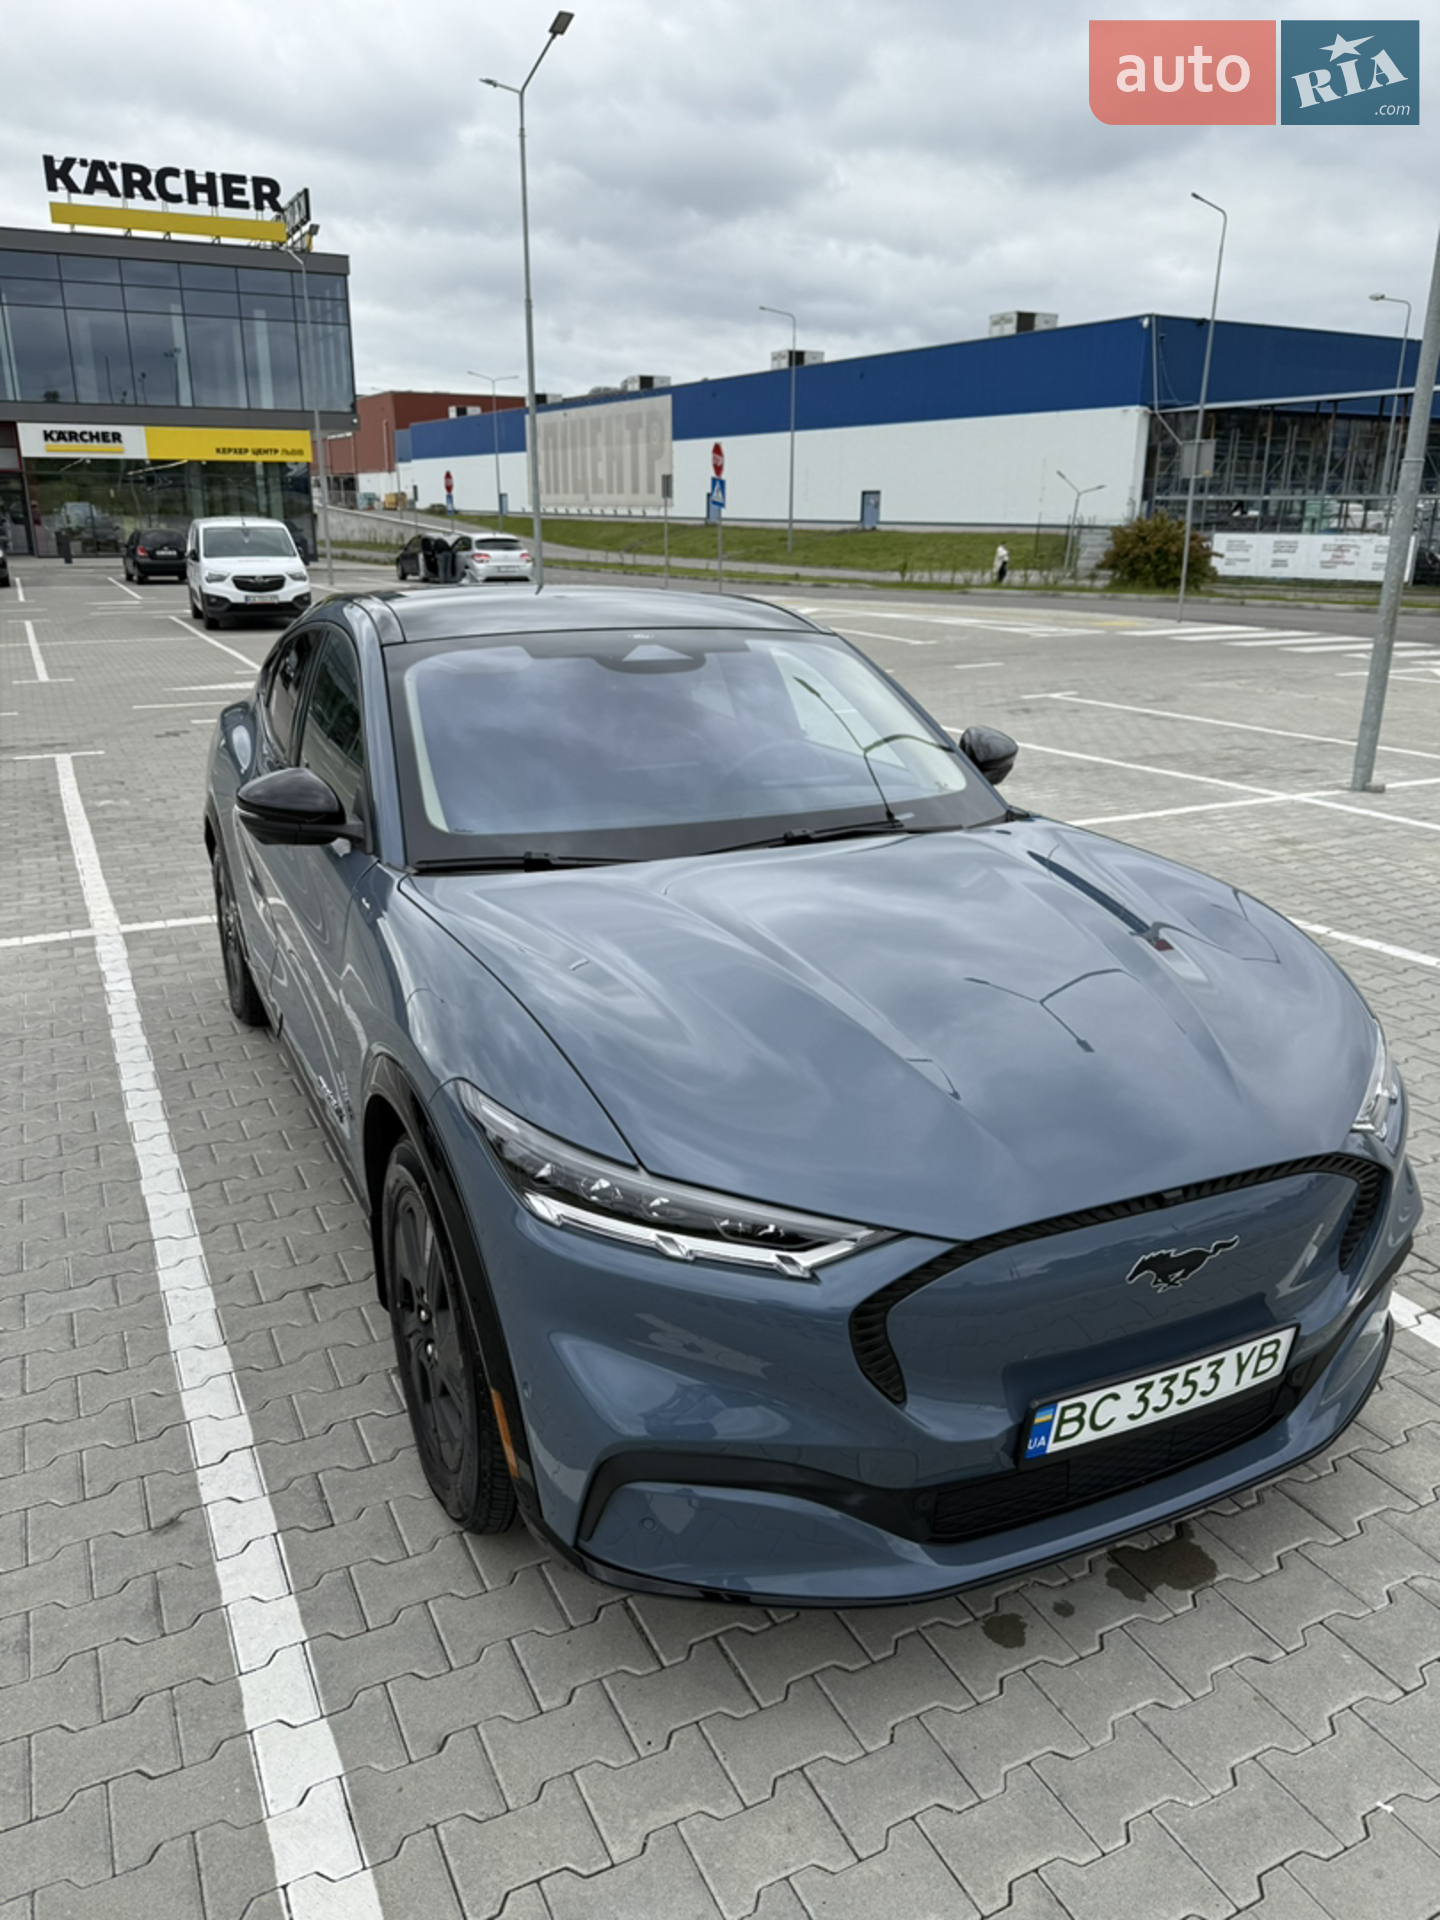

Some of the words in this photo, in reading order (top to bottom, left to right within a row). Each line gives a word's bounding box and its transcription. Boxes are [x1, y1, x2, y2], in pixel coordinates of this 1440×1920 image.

[42, 154, 285, 212] KÄRCHER
[43, 429, 123, 443] KÄRCHER
[1052, 1393, 1121, 1444] BC
[1127, 1357, 1225, 1421] 3353
[1235, 1338, 1281, 1386] YB
[1027, 1437, 1047, 1450] UA
